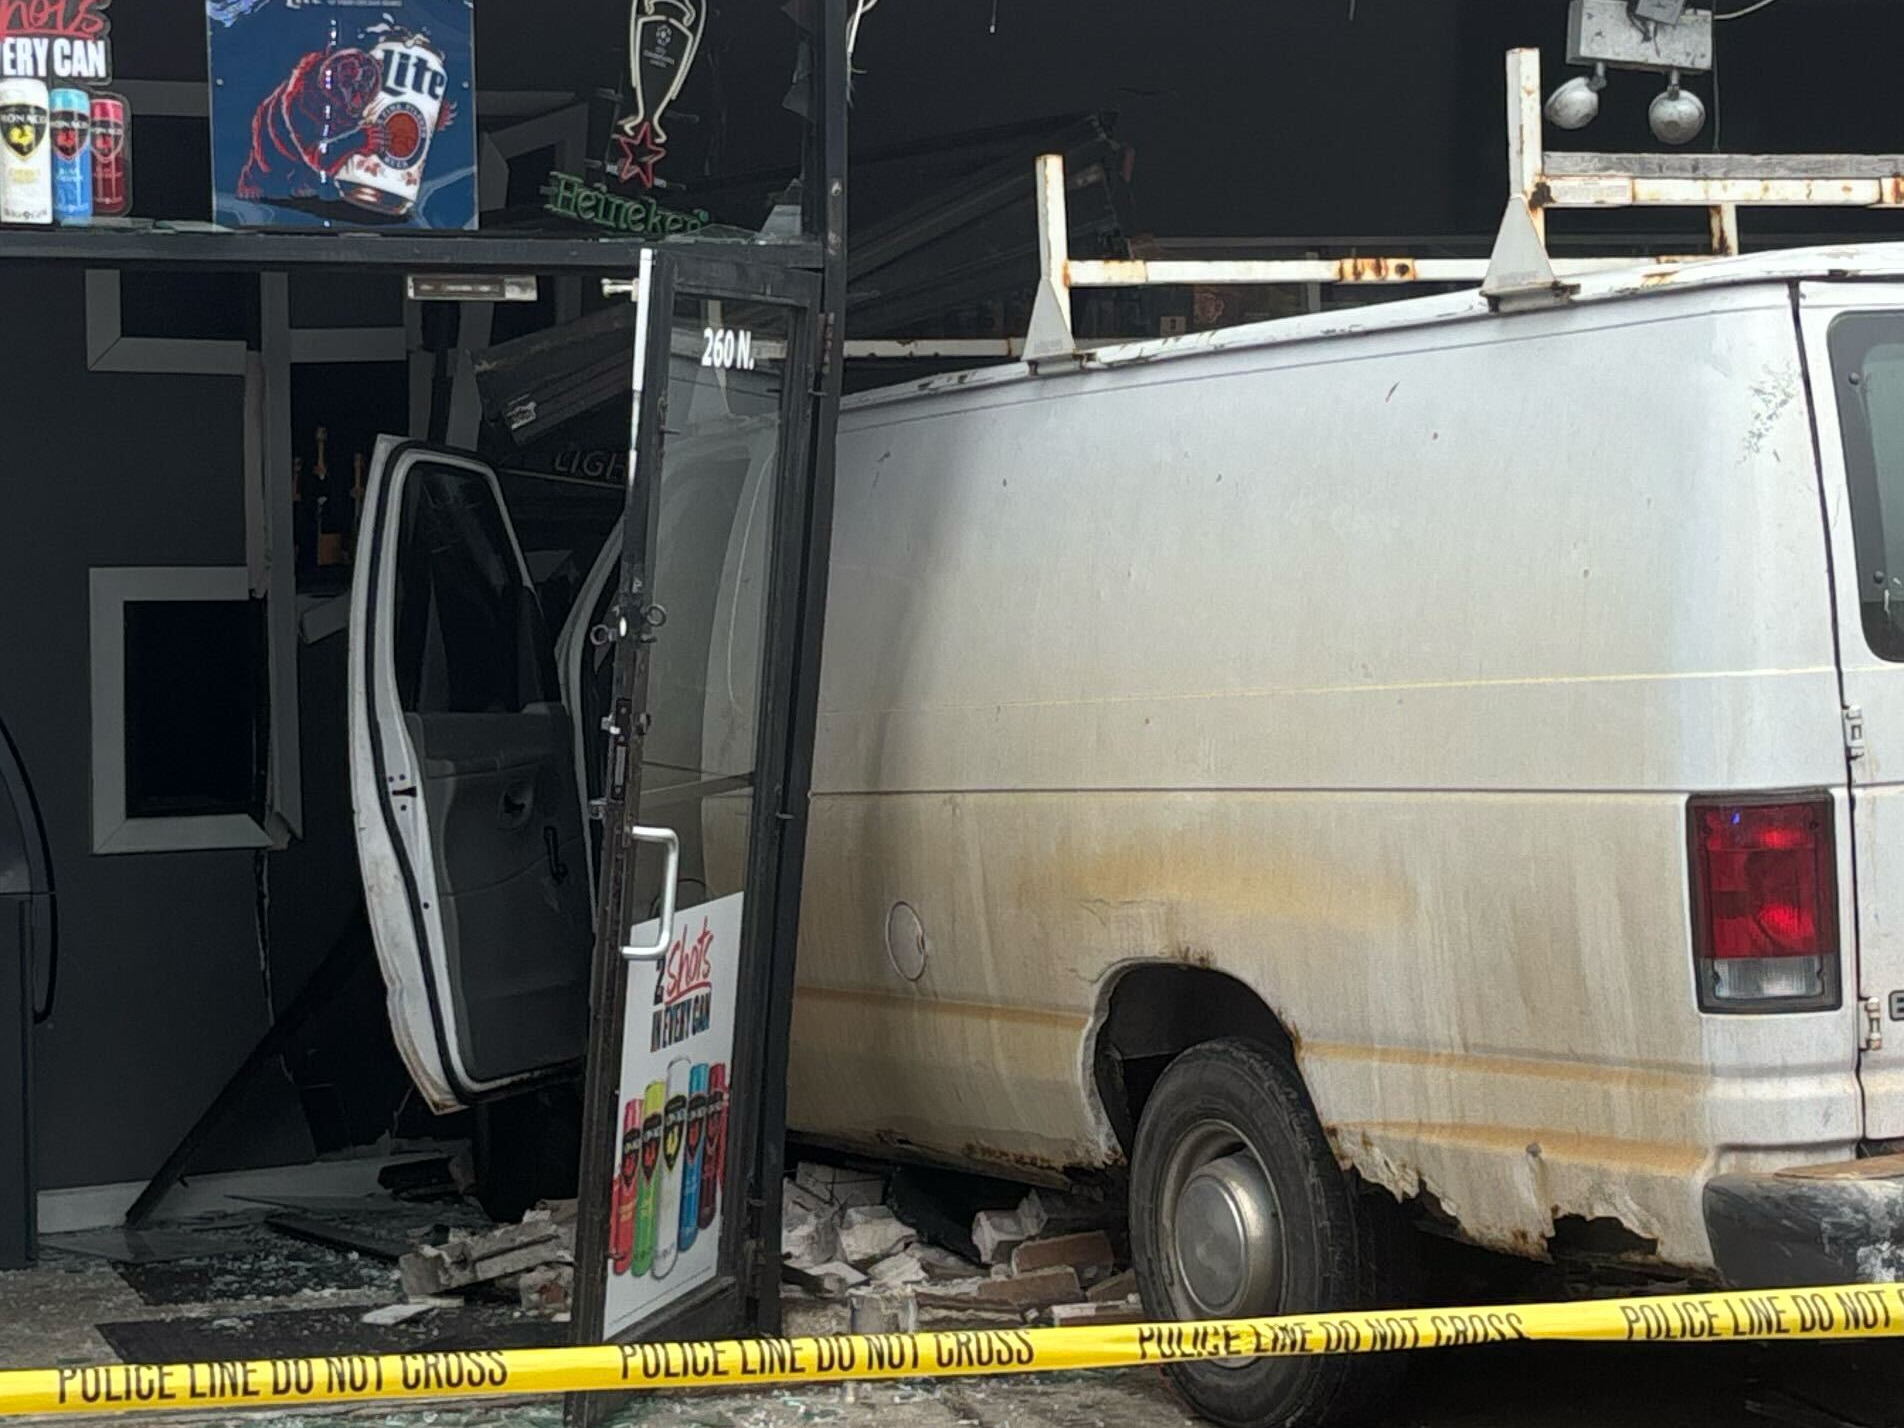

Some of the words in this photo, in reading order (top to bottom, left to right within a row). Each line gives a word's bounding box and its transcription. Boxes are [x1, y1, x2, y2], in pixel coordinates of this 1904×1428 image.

[53, 37, 107, 78] CAN
[379, 48, 447, 102] Lite
[548, 171, 702, 237] Heineken
[701, 327, 735, 368] 260
[736, 329, 755, 370] N.
[662, 997, 693, 1049] EVERY
[692, 991, 712, 1037] CAN
[1619, 1297, 1723, 1338] POLICE
[1723, 1294, 1792, 1336] LINE
[1796, 1292, 1836, 1334] DO
[1840, 1290, 1894, 1332] NOT
[57, 1365, 176, 1405] POLICE
[187, 1361, 262, 1401] LINE
[270, 1359, 313, 1398] DO
[324, 1356, 385, 1395] NOT
[402, 1350, 508, 1392] CROSS
[621, 1341, 730, 1382] POLICE
[739, 1339, 806, 1377] LINE
[816, 1337, 857, 1374] DO
[863, 1335, 923, 1373] NOT
[934, 1332, 1034, 1370] CROSS
